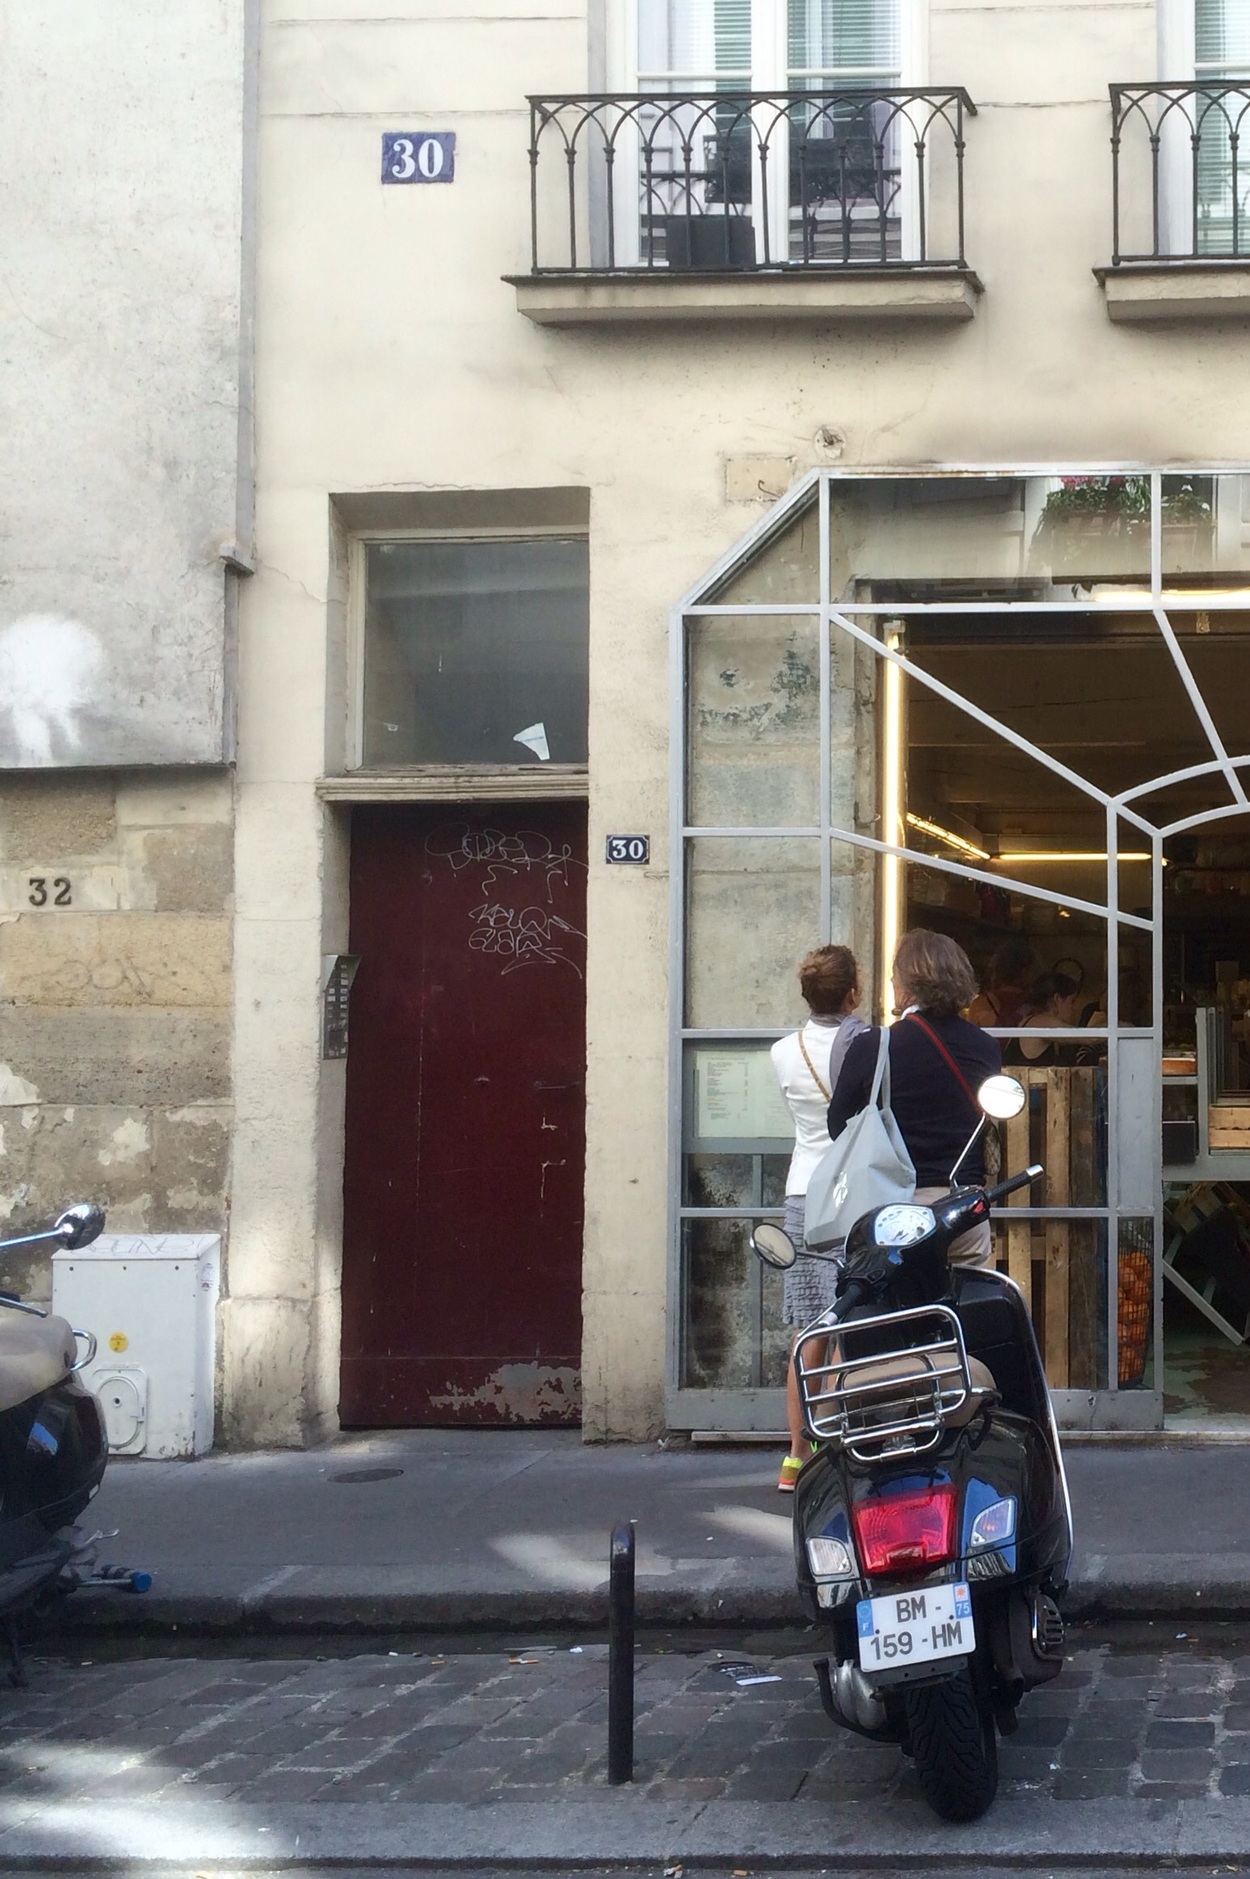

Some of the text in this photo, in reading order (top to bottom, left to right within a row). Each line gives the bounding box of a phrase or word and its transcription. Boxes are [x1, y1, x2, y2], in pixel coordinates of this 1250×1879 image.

[392, 138, 444, 178] 30
[612, 839, 644, 859] 30
[28, 877, 72, 907] 32
[956, 1602, 970, 1616] 75
[862, 1622, 869, 1632] F
